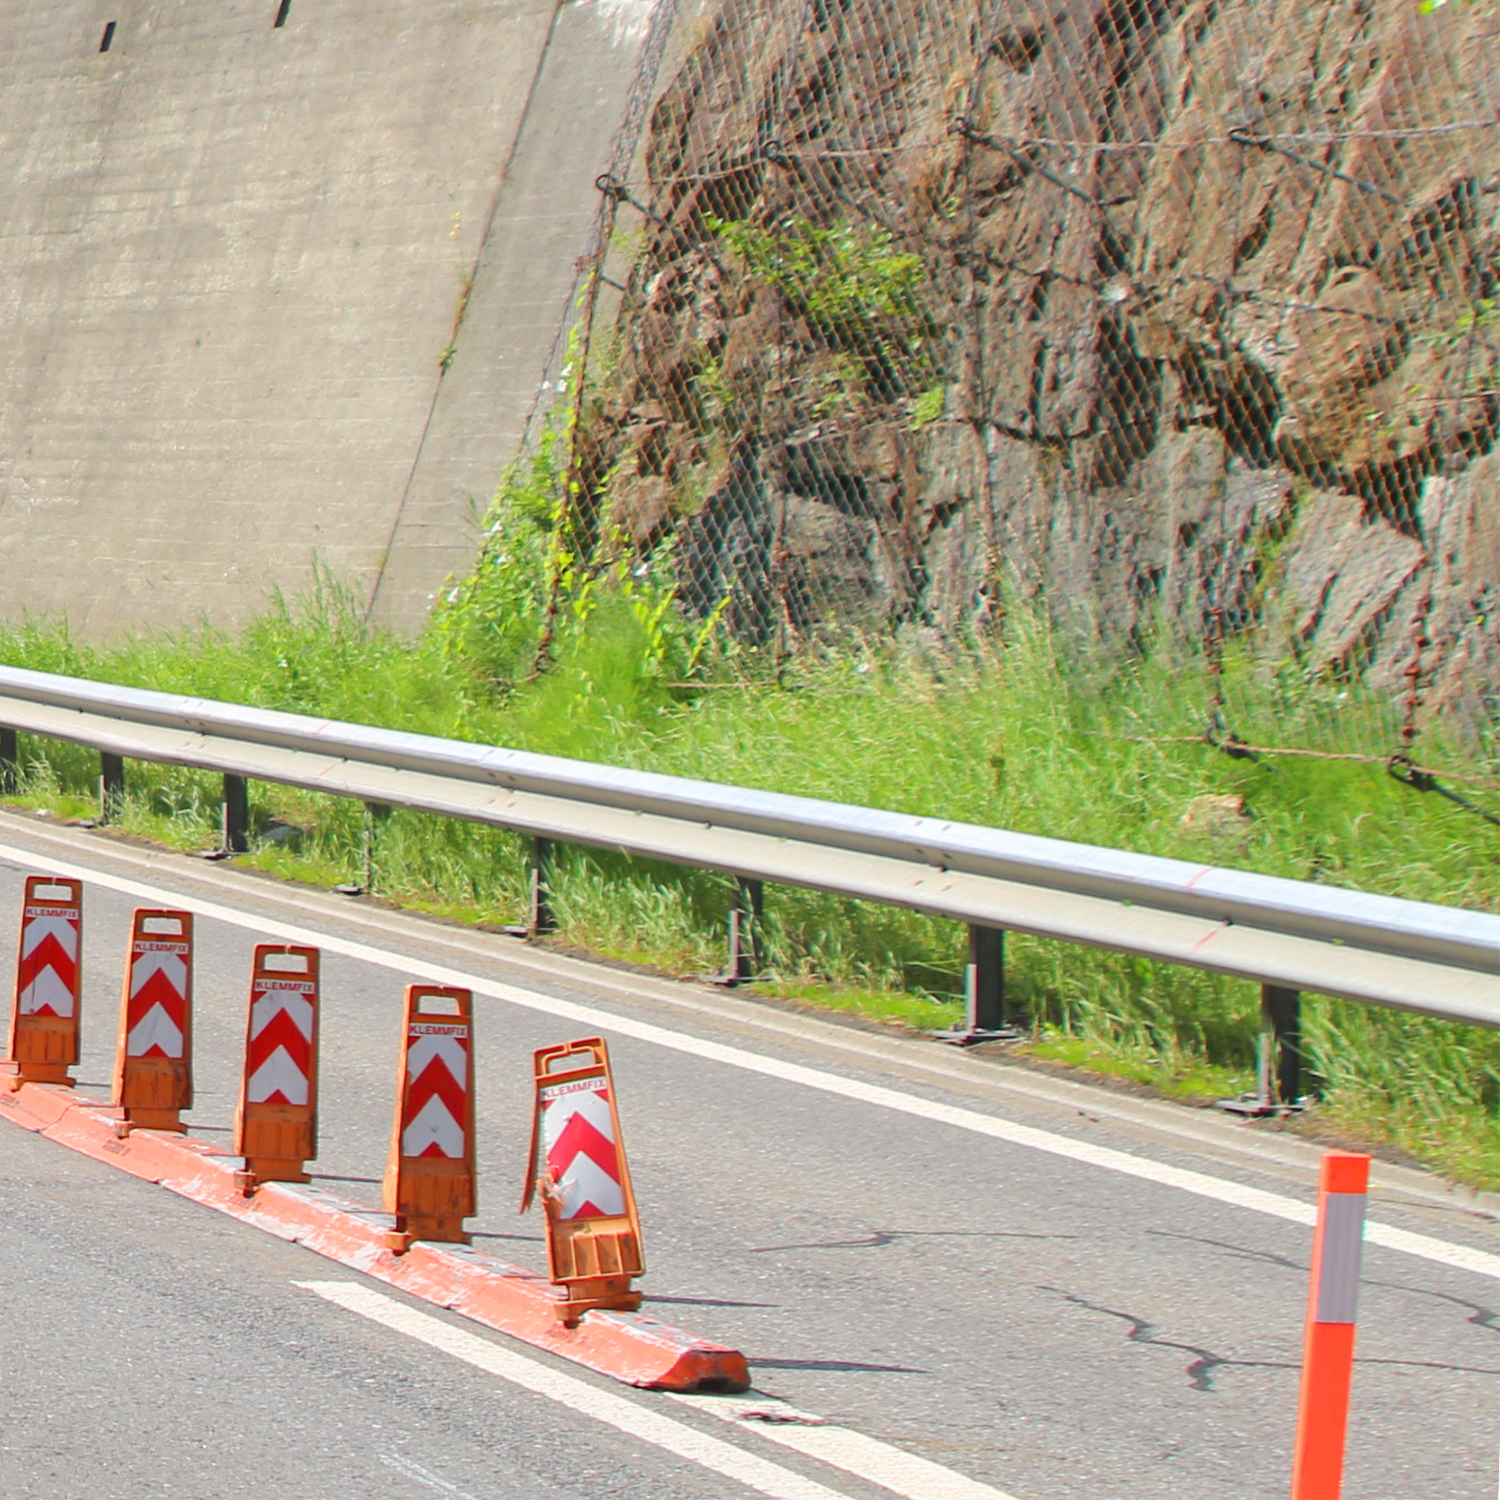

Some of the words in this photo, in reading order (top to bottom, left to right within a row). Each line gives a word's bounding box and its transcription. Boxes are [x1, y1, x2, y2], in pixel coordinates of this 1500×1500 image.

[26, 907, 78, 919] KLEMMFIX
[133, 941, 189, 954] KLEMMFIX
[255, 980, 314, 993] KLEMMFIX
[409, 1024, 468, 1038] KLEMMFIX
[542, 1078, 606, 1098] KLEMMFIX
